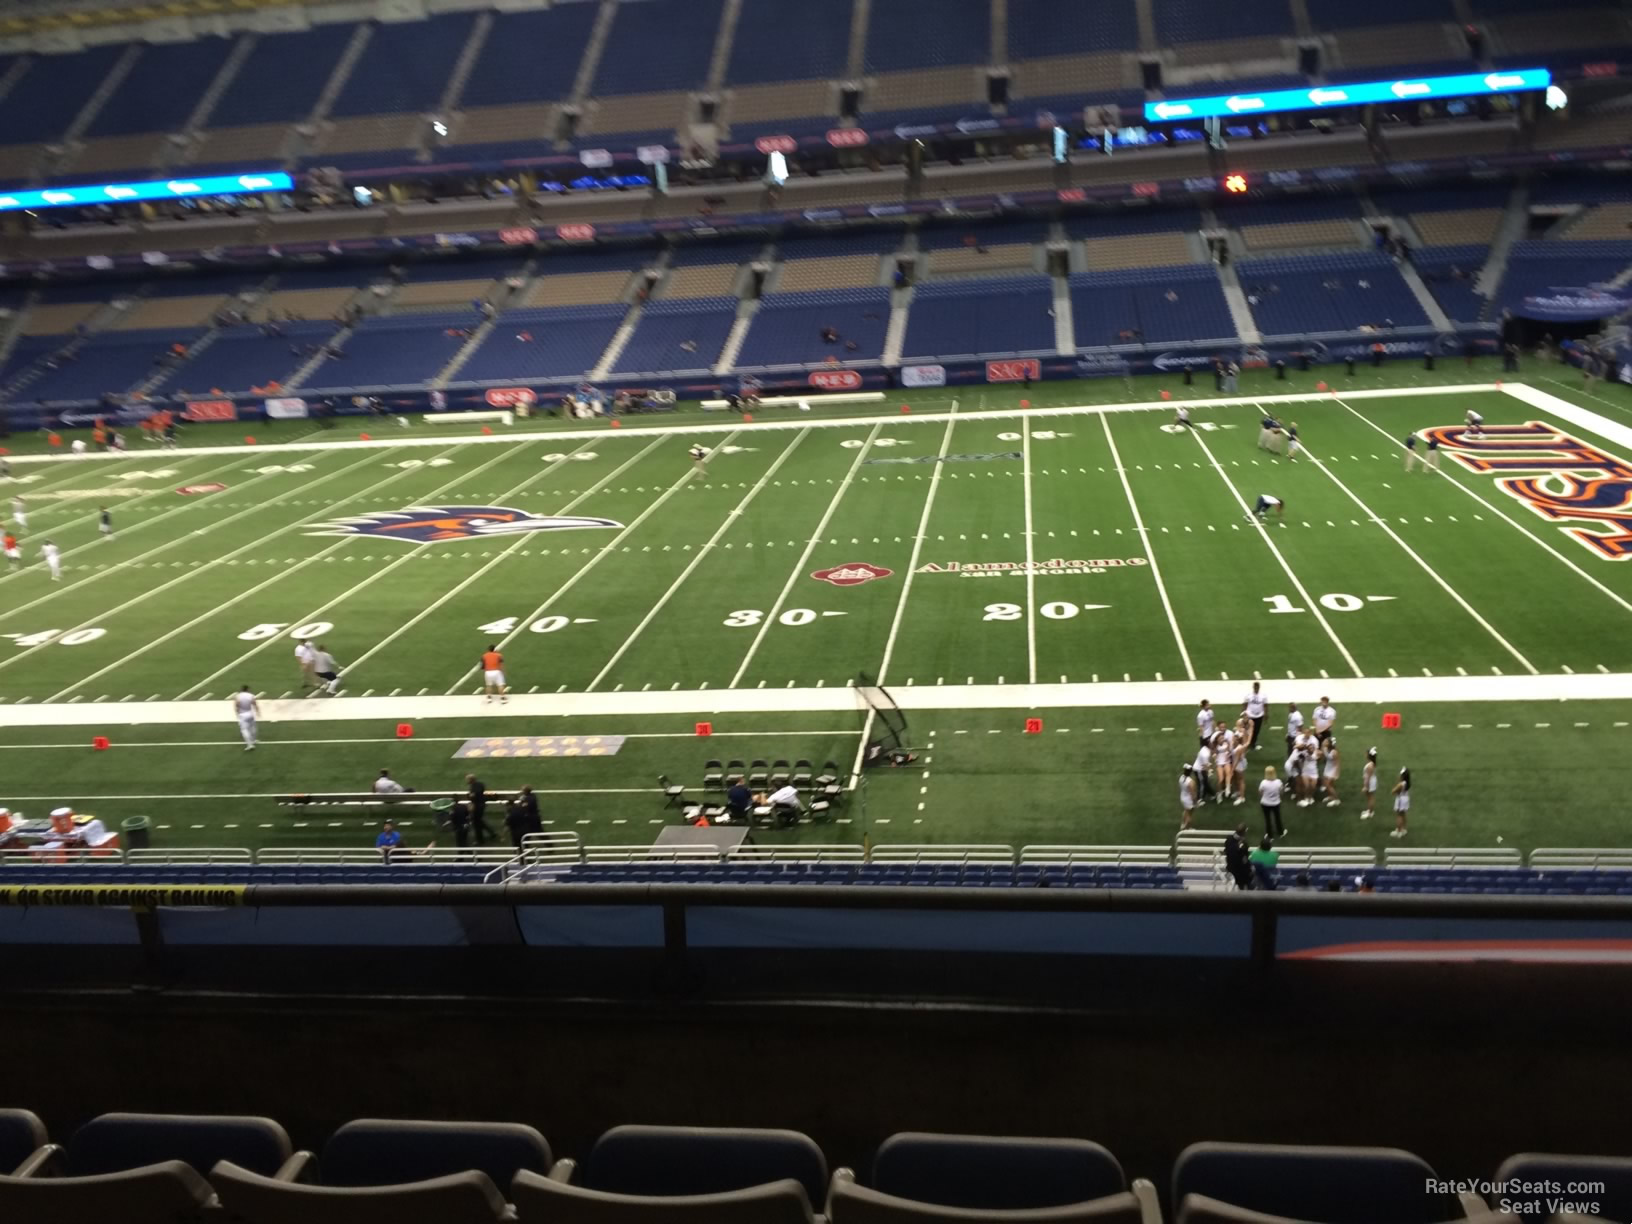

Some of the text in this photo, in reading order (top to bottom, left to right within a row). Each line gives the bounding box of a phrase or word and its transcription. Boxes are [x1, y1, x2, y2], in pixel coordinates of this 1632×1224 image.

[914, 557, 1149, 573] Alamodome
[983, 601, 1079, 621] 20
[1262, 593, 1364, 613] 10
[476, 615, 570, 635] 40
[722, 608, 817, 627] 30
[237, 621, 334, 640] 50
[97, 889, 168, 905] AGAINST
